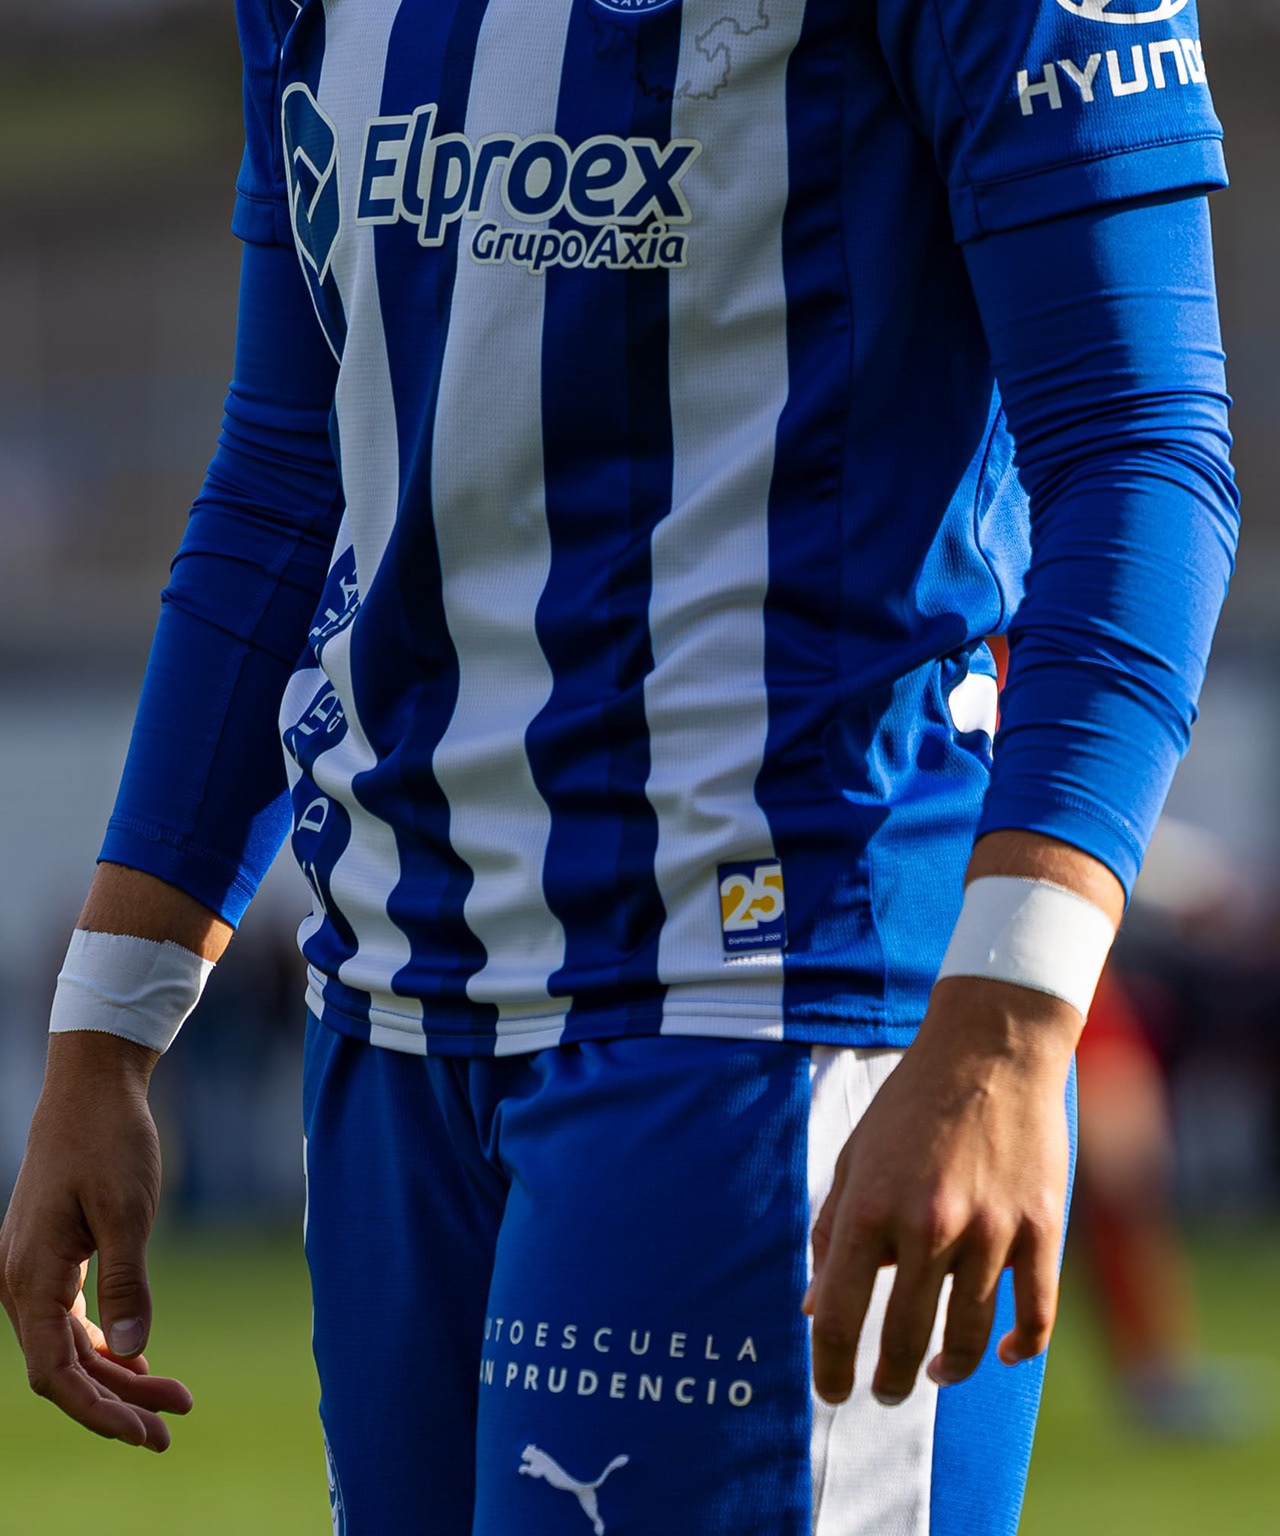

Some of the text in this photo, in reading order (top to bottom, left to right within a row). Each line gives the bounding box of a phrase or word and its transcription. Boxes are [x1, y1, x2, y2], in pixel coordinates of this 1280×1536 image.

[1017, 38, 1207, 115] HYUND
[356, 107, 699, 242] Elproex
[720, 865, 784, 931] 25
[484, 1318, 758, 1363] UTOESCUELA
[505, 1362, 753, 1407] PRUDENCIO
